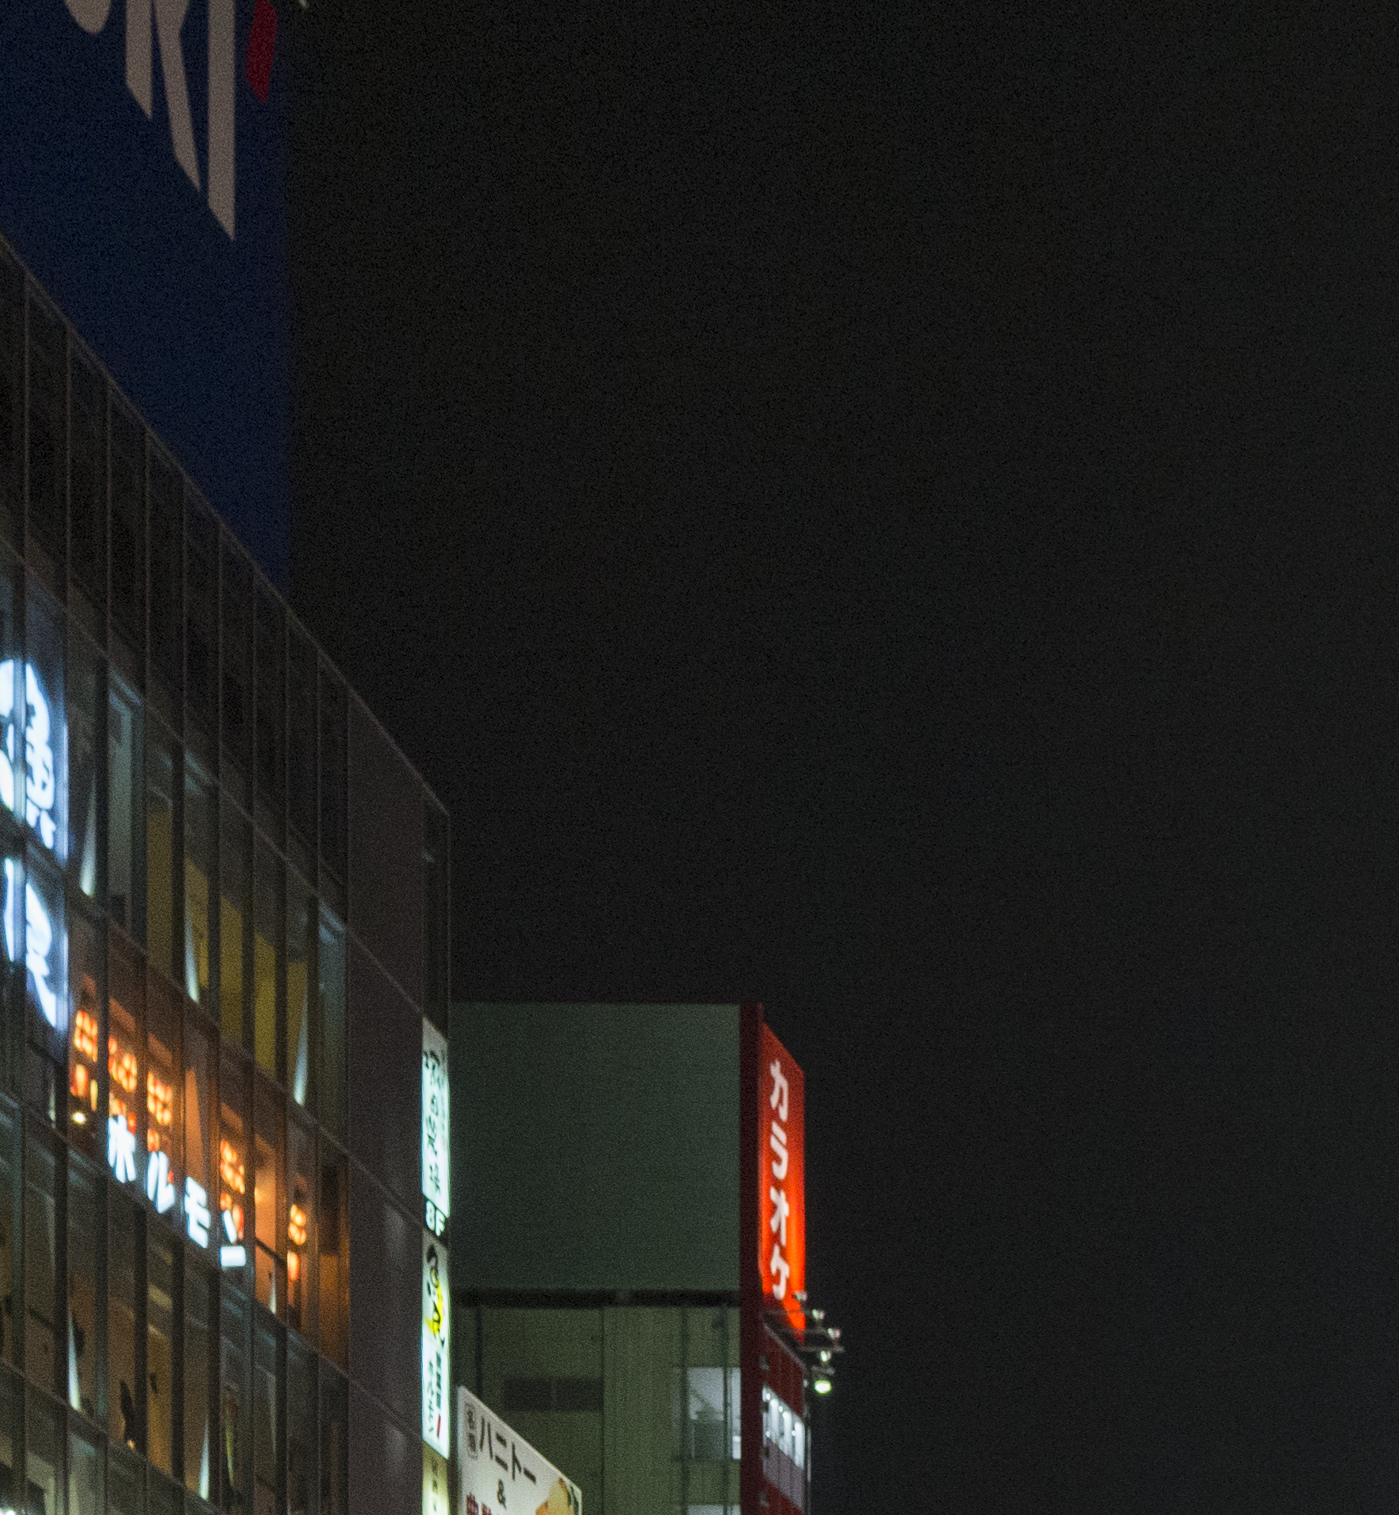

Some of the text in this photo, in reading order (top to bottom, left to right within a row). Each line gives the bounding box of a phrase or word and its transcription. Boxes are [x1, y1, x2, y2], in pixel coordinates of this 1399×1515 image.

[769, 1058, 791, 1301] カラオケ
[479, 1416, 538, 1485] ハニトー
